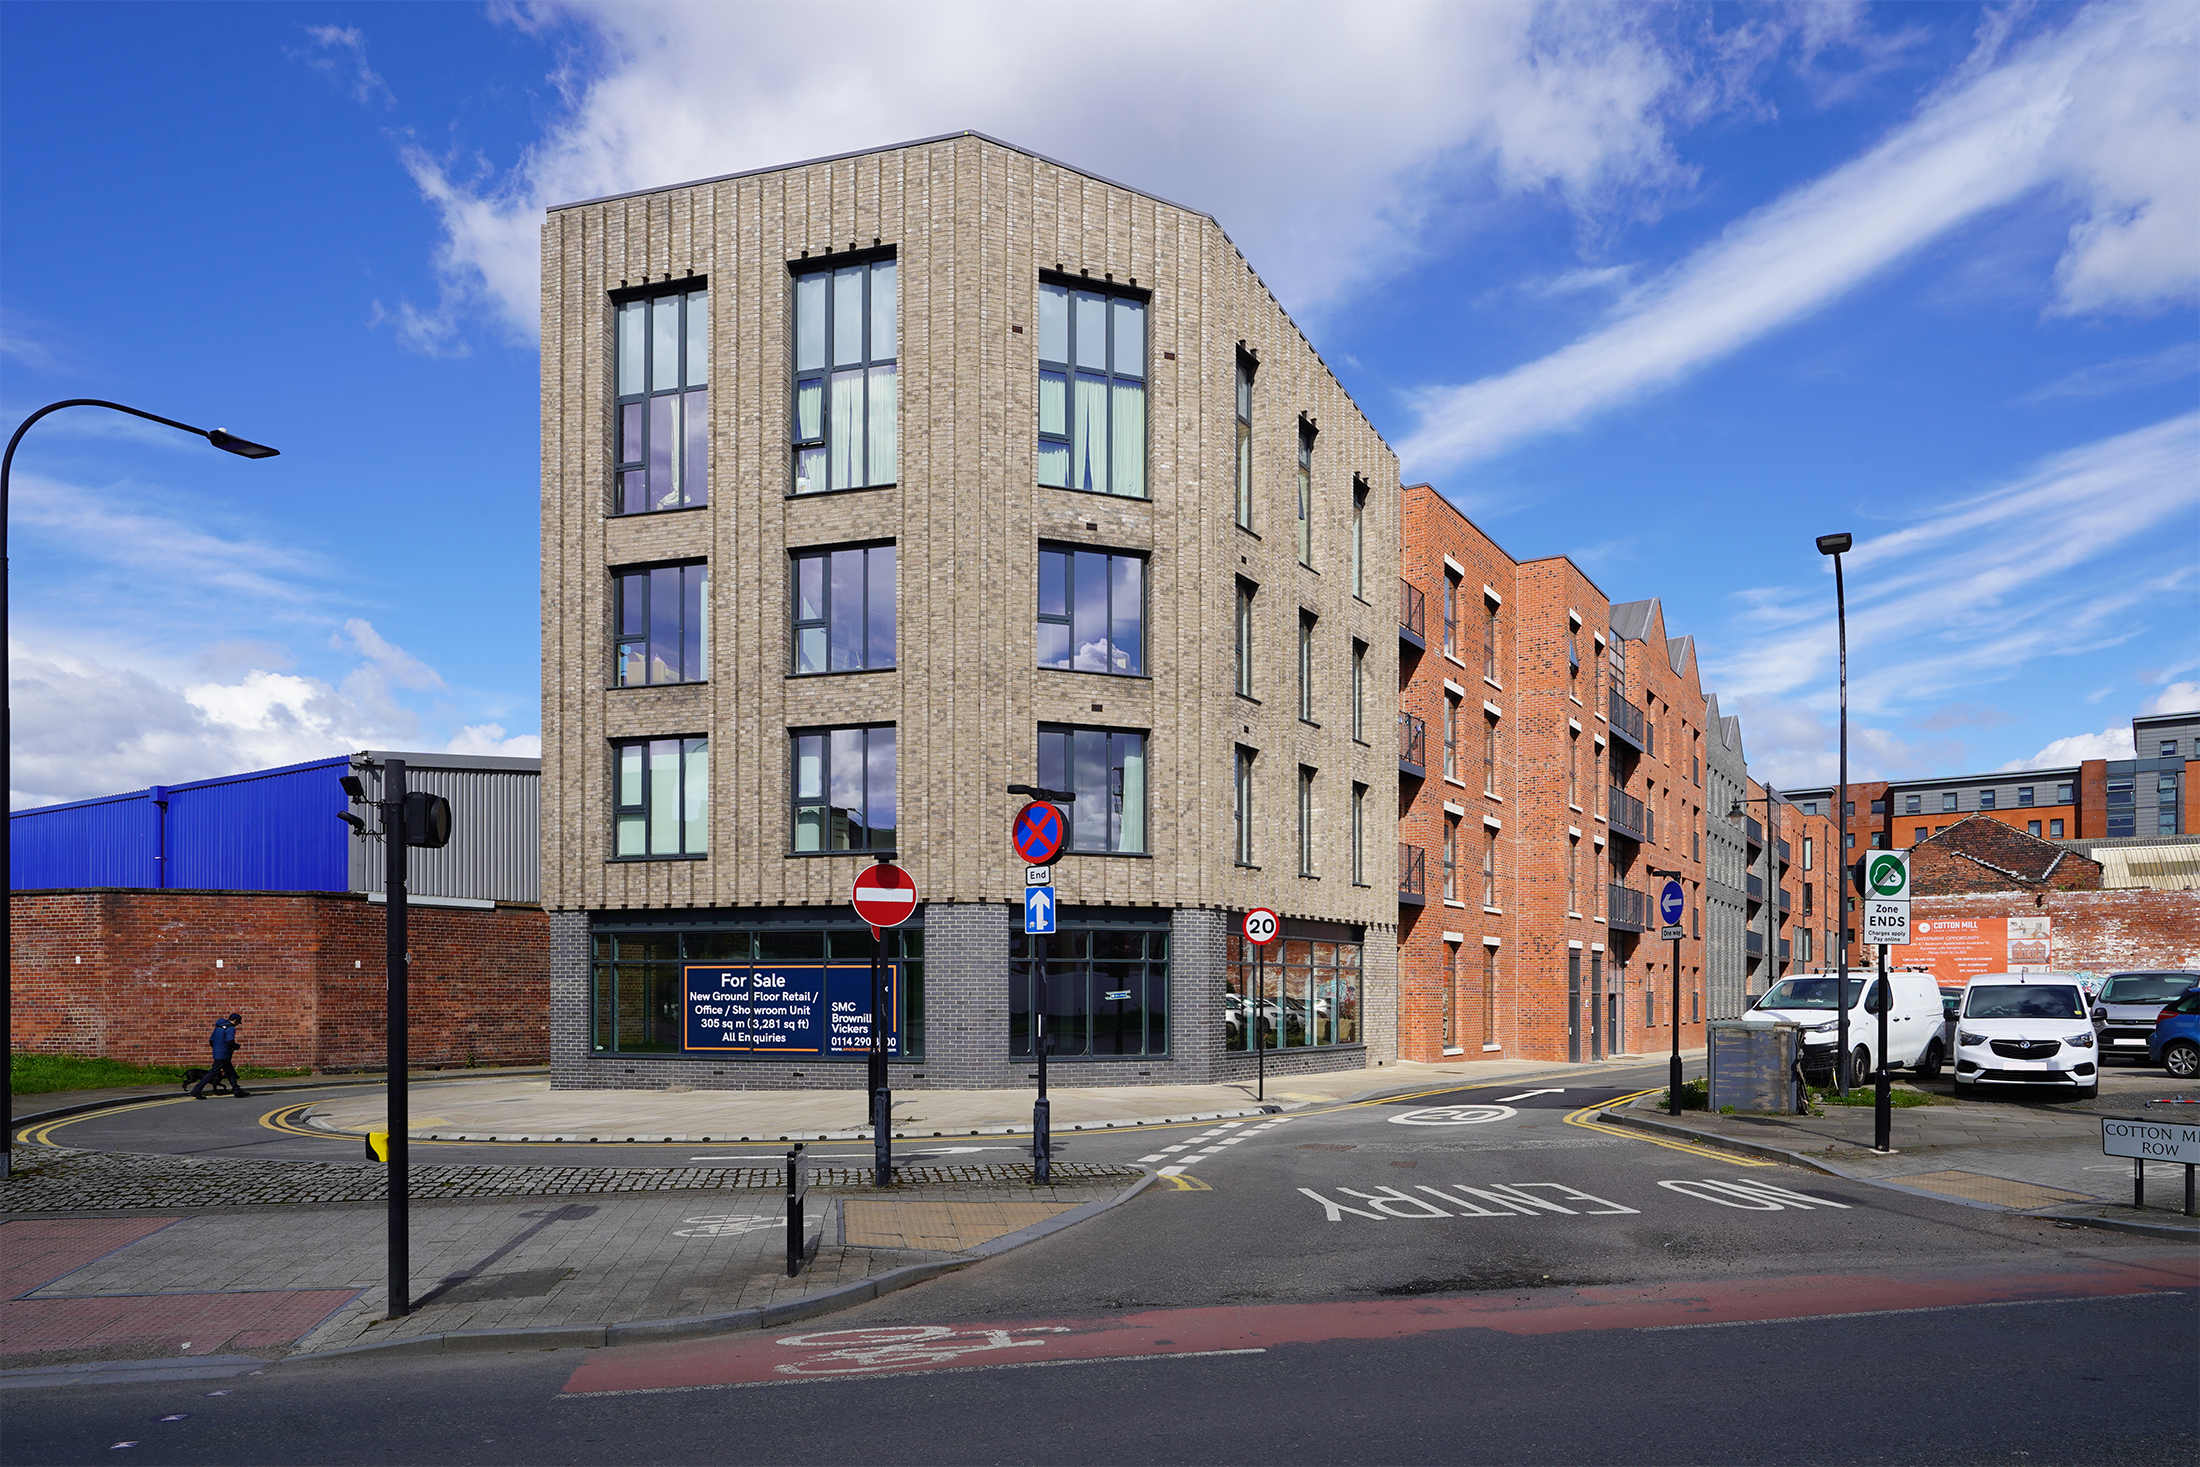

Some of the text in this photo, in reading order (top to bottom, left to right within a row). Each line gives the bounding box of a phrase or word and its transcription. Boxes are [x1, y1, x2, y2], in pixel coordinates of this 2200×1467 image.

[1030, 871, 1046, 880] End
[1876, 904, 1898, 913] Zone
[1249, 918, 1274, 934] 20
[1870, 916, 1905, 927] ENDS
[721, 973, 786, 988] For Sale
[690, 992, 819, 1003] New Ground Floor Retail /
[695, 1005, 810, 1017] Office / Showroom Unit
[831, 1002, 856, 1011] SMC
[832, 1014, 872, 1023] Brownill
[701, 1019, 720, 1029] 305
[722, 1021, 733, 1030] sq
[747, 1019, 781, 1030] (3,281
[784, 1021, 795, 1030] sq
[798, 1019, 809, 1029] ft)
[831, 1024, 868, 1033] Vickers
[722, 1033, 786, 1044] All Enquiries
[831, 1037, 852, 1046] 0114
[854, 1037, 871, 1046] 290
[1410, 1110, 1500, 1121] 20
[2105, 1124, 2172, 1140] COTTON
[2142, 1142, 2179, 1156] ROW
[1296, 1178, 1854, 1222] NO ENTRY
